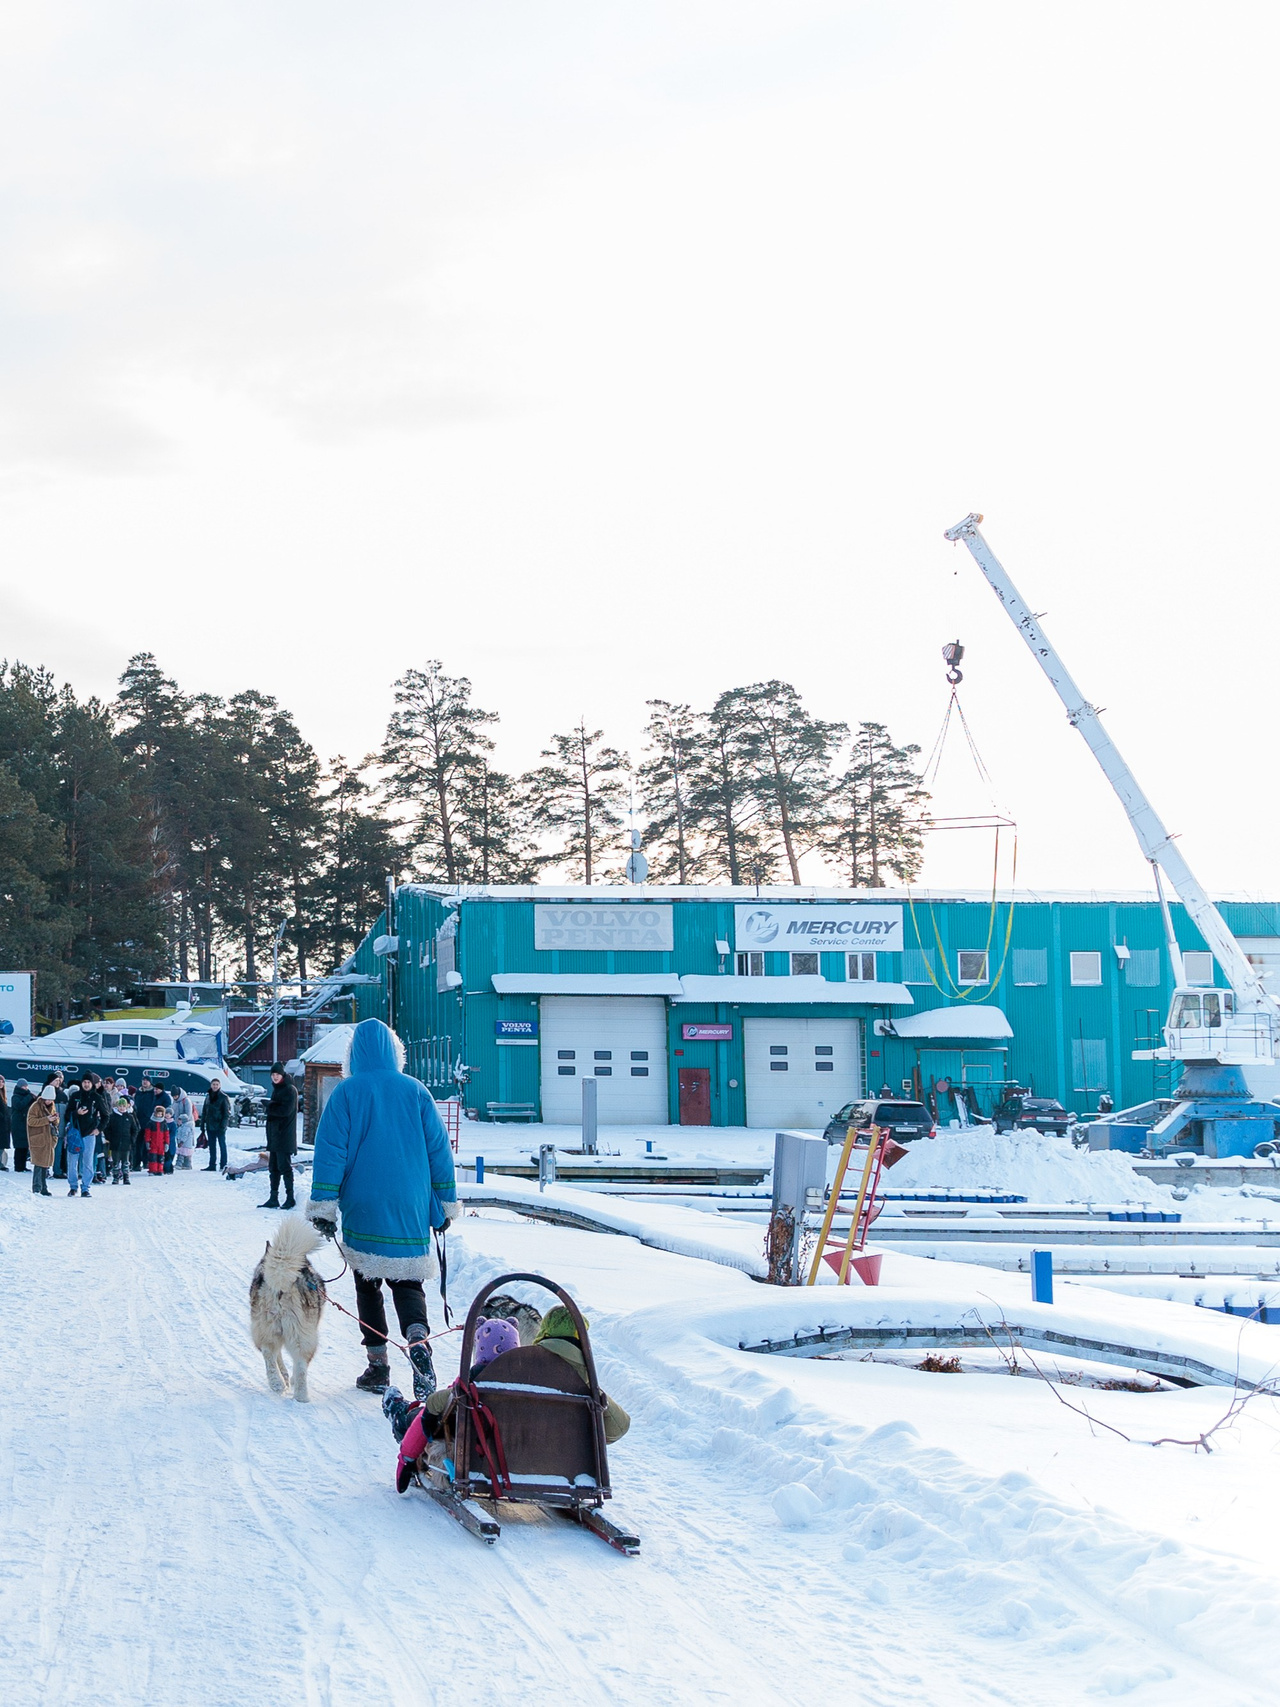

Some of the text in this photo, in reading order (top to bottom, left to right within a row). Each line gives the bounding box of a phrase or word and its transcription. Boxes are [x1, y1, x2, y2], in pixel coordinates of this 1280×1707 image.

[542, 910, 661, 927] VOLVO
[786, 920, 899, 935] MERCURY
[541, 928, 667, 945] PENTA
[809, 937, 887, 946] Service Center
